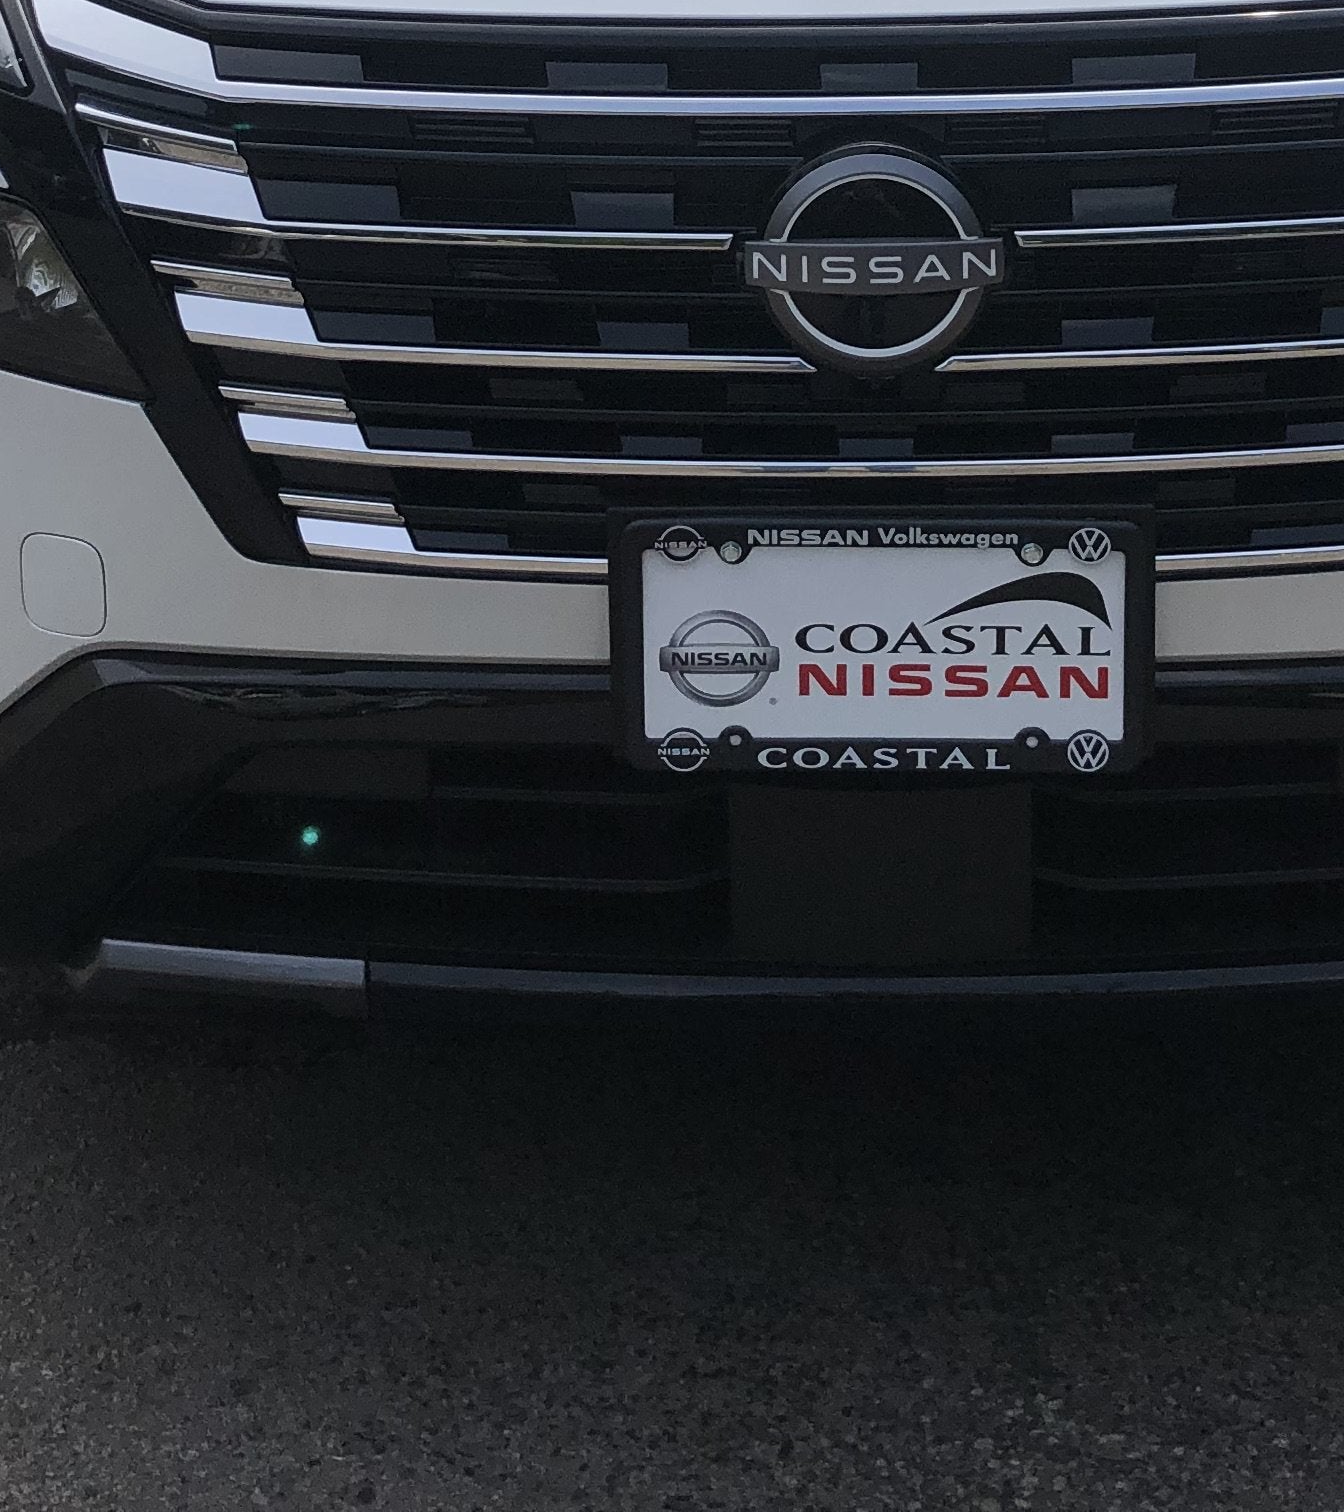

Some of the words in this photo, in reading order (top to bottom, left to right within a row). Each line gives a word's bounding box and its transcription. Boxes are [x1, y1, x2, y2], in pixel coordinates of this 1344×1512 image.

[752, 249, 996, 284] NISSAN
[655, 540, 707, 549] NISSAN
[747, 529, 869, 546] NISSAN
[877, 527, 1019, 549] Volkswagen
[795, 621, 1111, 656] COASTAL
[671, 651, 767, 666] NISSAN
[798, 663, 1109, 699] NISSAN
[657, 747, 710, 756] NISSAN
[757, 746, 1010, 770] COASTAL
